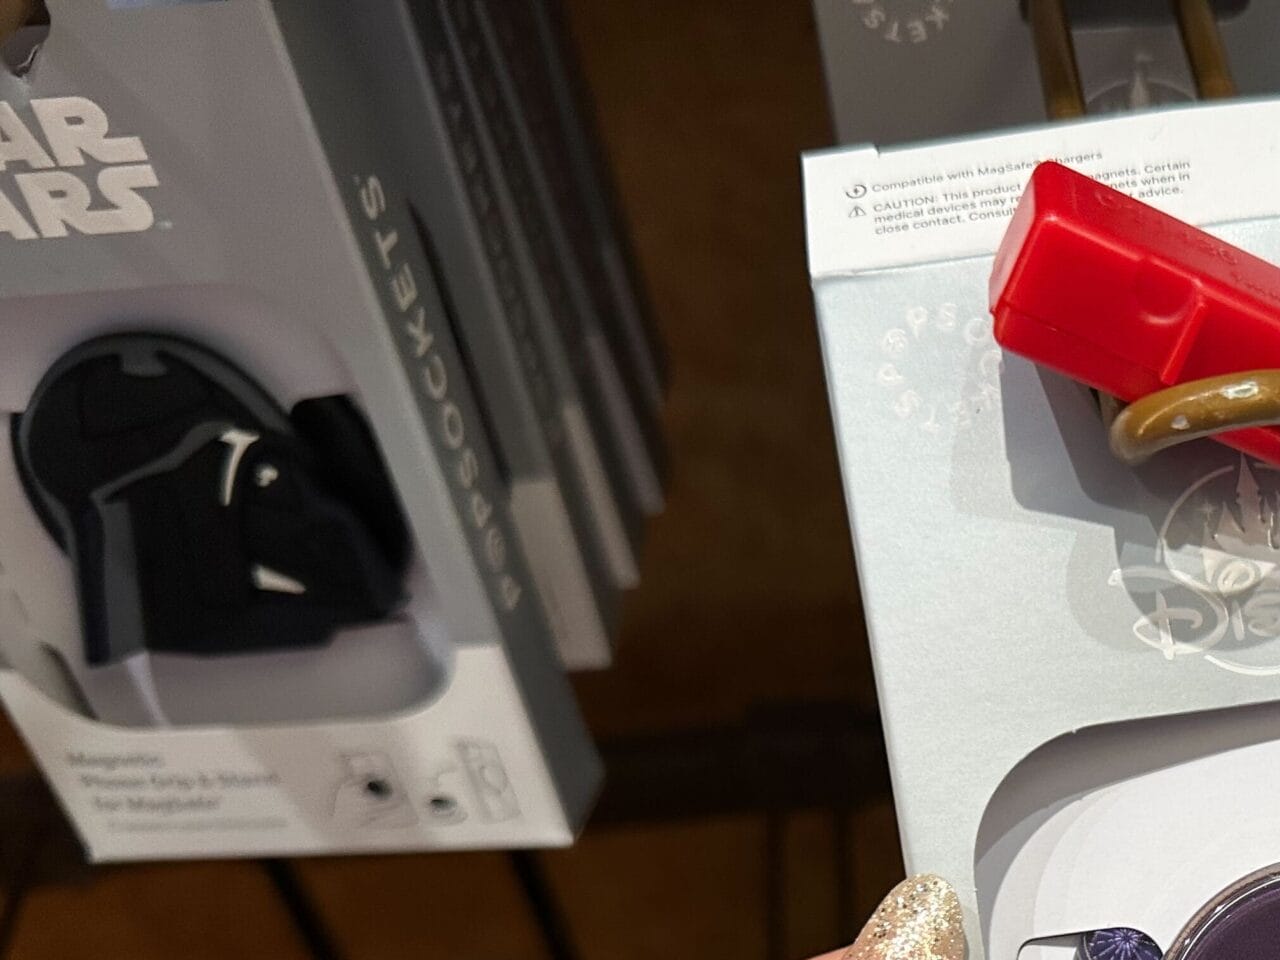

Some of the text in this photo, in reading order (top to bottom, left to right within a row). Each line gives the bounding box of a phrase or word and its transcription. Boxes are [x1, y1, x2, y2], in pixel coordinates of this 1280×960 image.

[0, 96, 149, 171] AR
[871, 174, 943, 193] Compatible
[947, 169, 974, 182] with
[873, 196, 939, 212] CAUTION:
[942, 192, 969, 202] This
[972, 184, 1021, 199] product
[1144, 161, 1190, 174] Certain
[874, 209, 924, 224] medical
[927, 202, 977, 216] devices
[980, 197, 1006, 208] may
[1141, 174, 1176, 185] when
[1178, 173, 1190, 181] in
[875, 223, 909, 235] close
[913, 215, 965, 229] contact.
[1138, 186, 1183, 198] advice.
